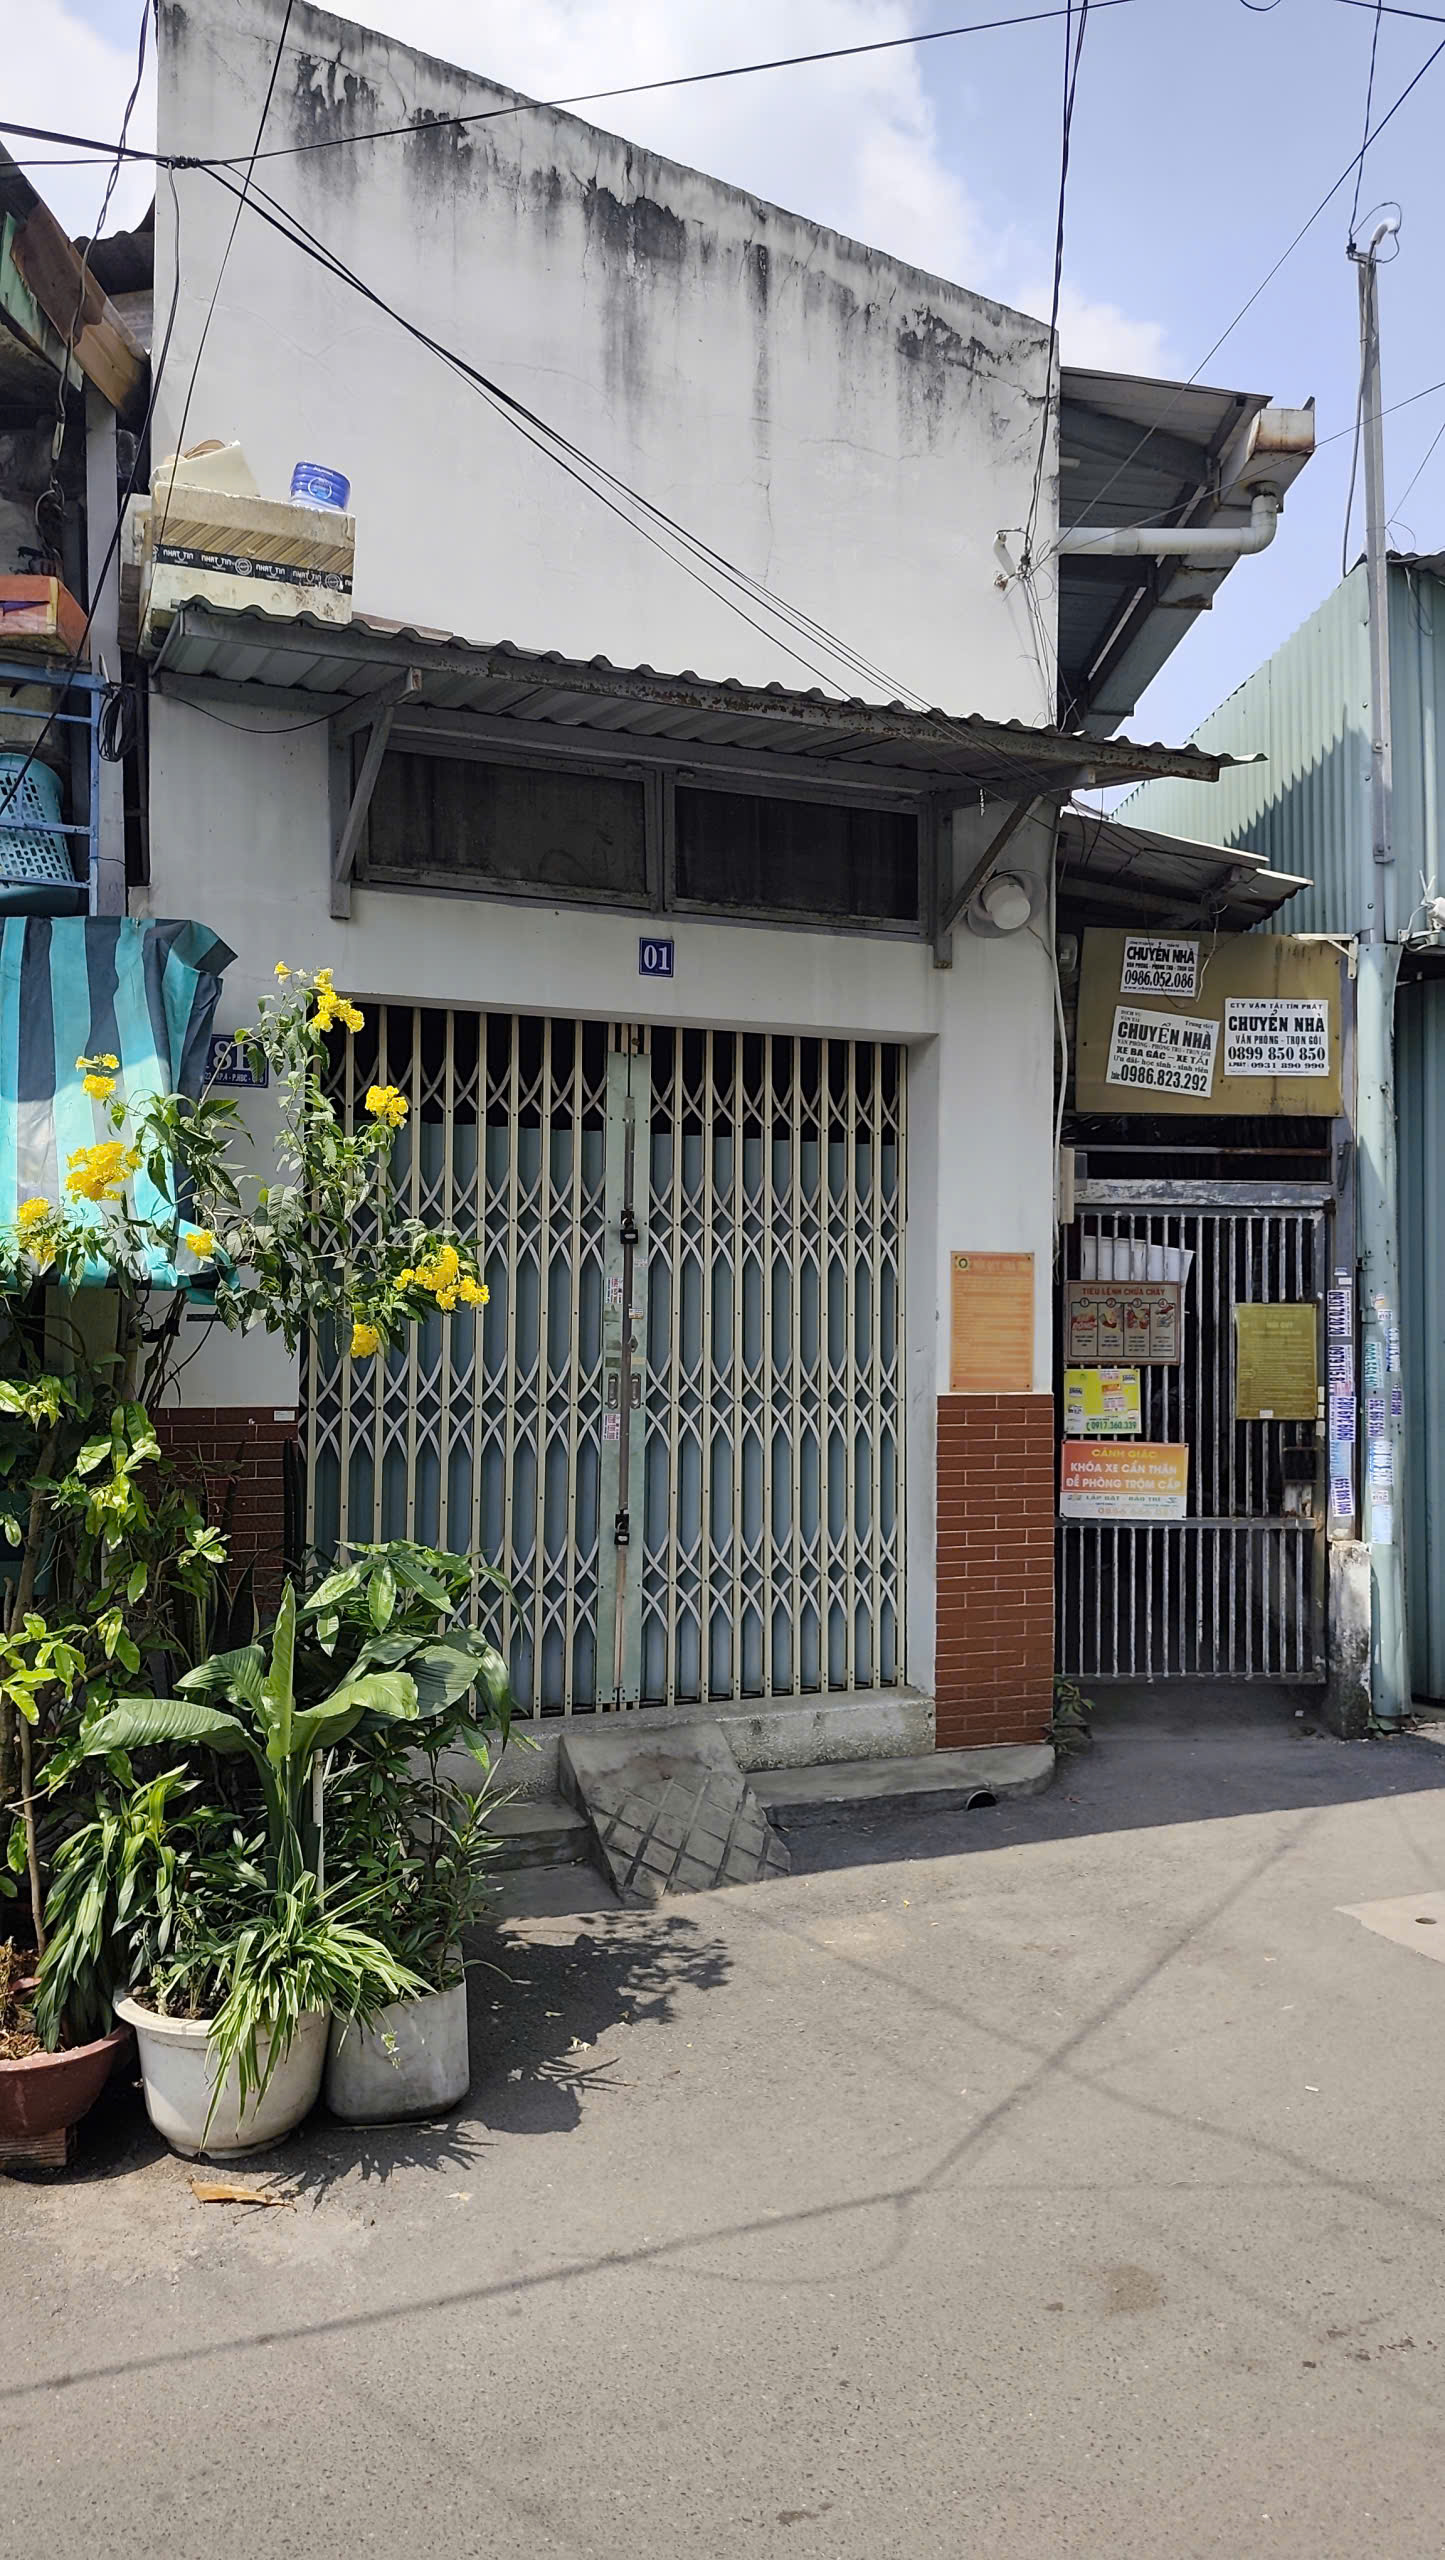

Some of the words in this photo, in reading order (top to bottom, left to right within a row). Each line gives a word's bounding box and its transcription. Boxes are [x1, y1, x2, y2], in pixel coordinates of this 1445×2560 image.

[643, 944, 670, 970] 01
[1125, 969, 1194, 988] 0986.052.086
[1228, 1009, 1288, 1032] CHUYỂN
[1294, 1013, 1325, 1032] NHÀ
[1117, 1021, 1180, 1046] CHUYỂN
[1182, 1030, 1211, 1050] NHÀ
[1254, 1034, 1279, 1045] PHÒNG
[1286, 1035, 1307, 1047] TRỌN
[1116, 1046, 1128, 1054] XE
[1130, 1048, 1143, 1057] BA
[1146, 1050, 1166, 1060] GÁC
[1176, 1054, 1188, 1063] XE
[1191, 1056, 1209, 1066] TẢI
[1228, 1046, 1263, 1060] 0899
[1268, 1046, 1294, 1061] 850
[1299, 1047, 1326, 1061] 850
[1141, 1058, 1154, 1067] học
[1156, 1061, 1171, 1069] sinh
[1177, 1063, 1192, 1071] sinh
[1120, 1064, 1208, 1092] 0986.823.292
[1091, 1447, 1125, 1457] CẢNH
[1127, 1448, 1158, 1458] GIÁC
[1070, 1461, 1102, 1472] KHÓA
[1105, 1463, 1119, 1473] XE
[1082, 1477, 1122, 1488] PHÒNG
